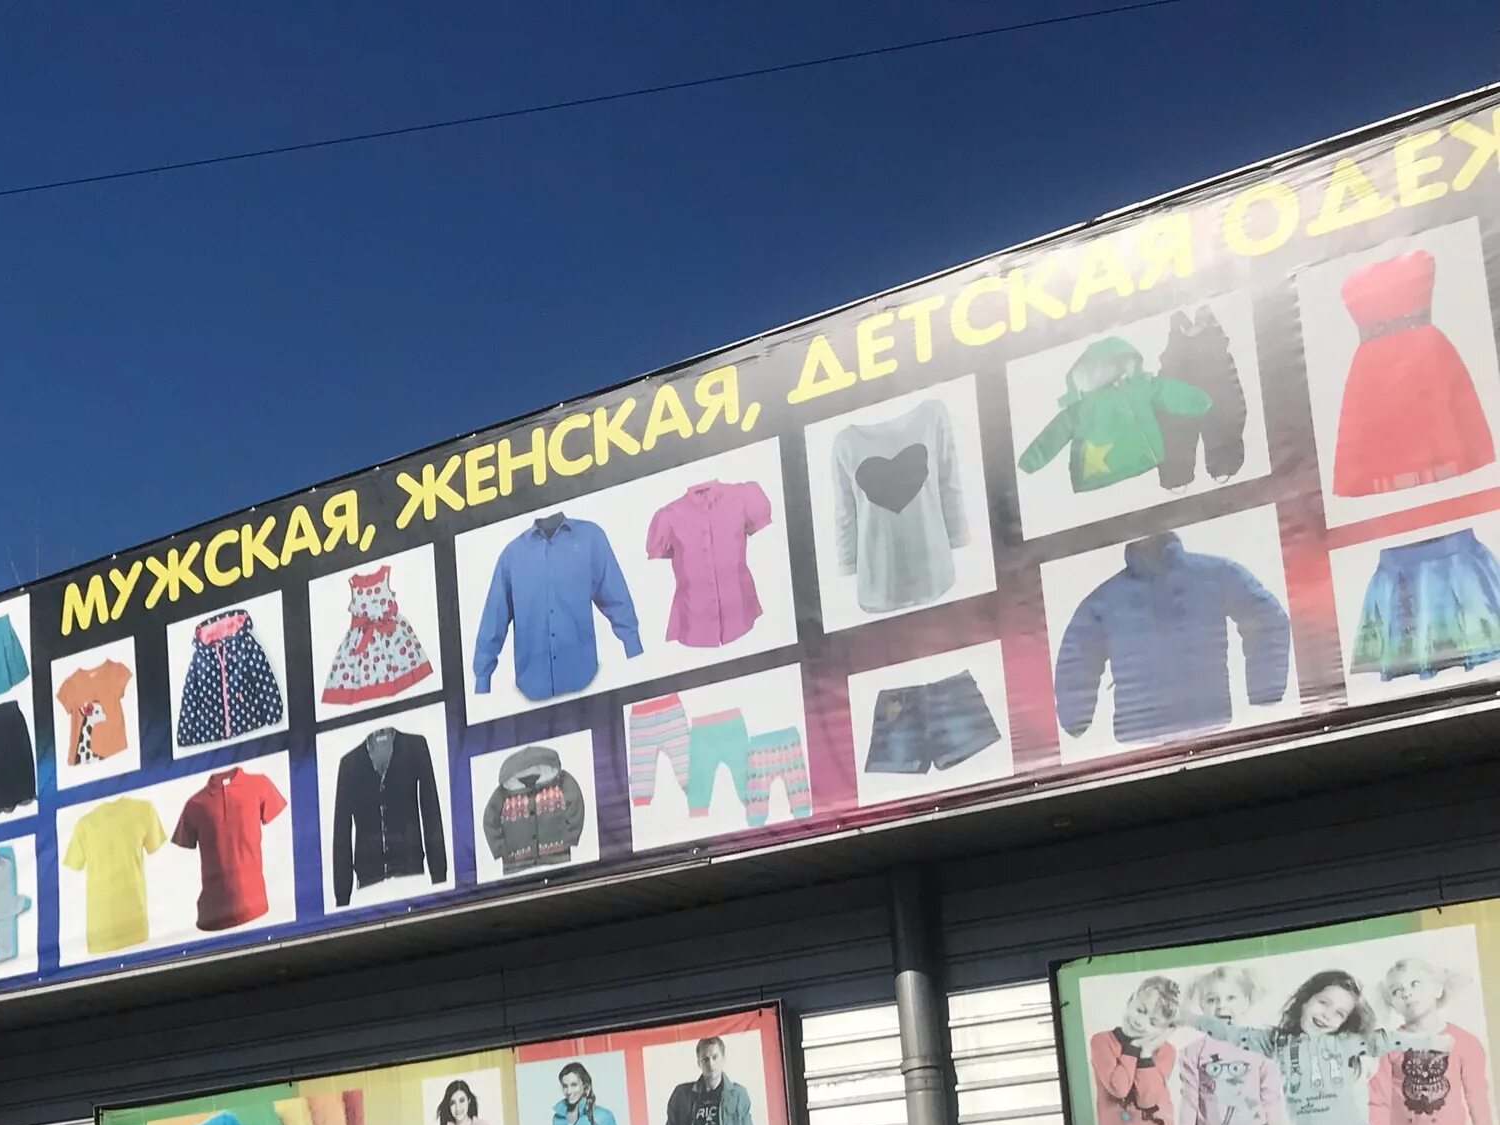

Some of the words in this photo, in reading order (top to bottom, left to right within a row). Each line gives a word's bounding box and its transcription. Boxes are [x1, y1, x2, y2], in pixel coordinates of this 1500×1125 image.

[60, 488, 377, 636] МУЖСКАЯ,
[395, 365, 762, 530] ЖЕНСКАЯ,
[786, 210, 1194, 404] ДЕТСКАЯ
